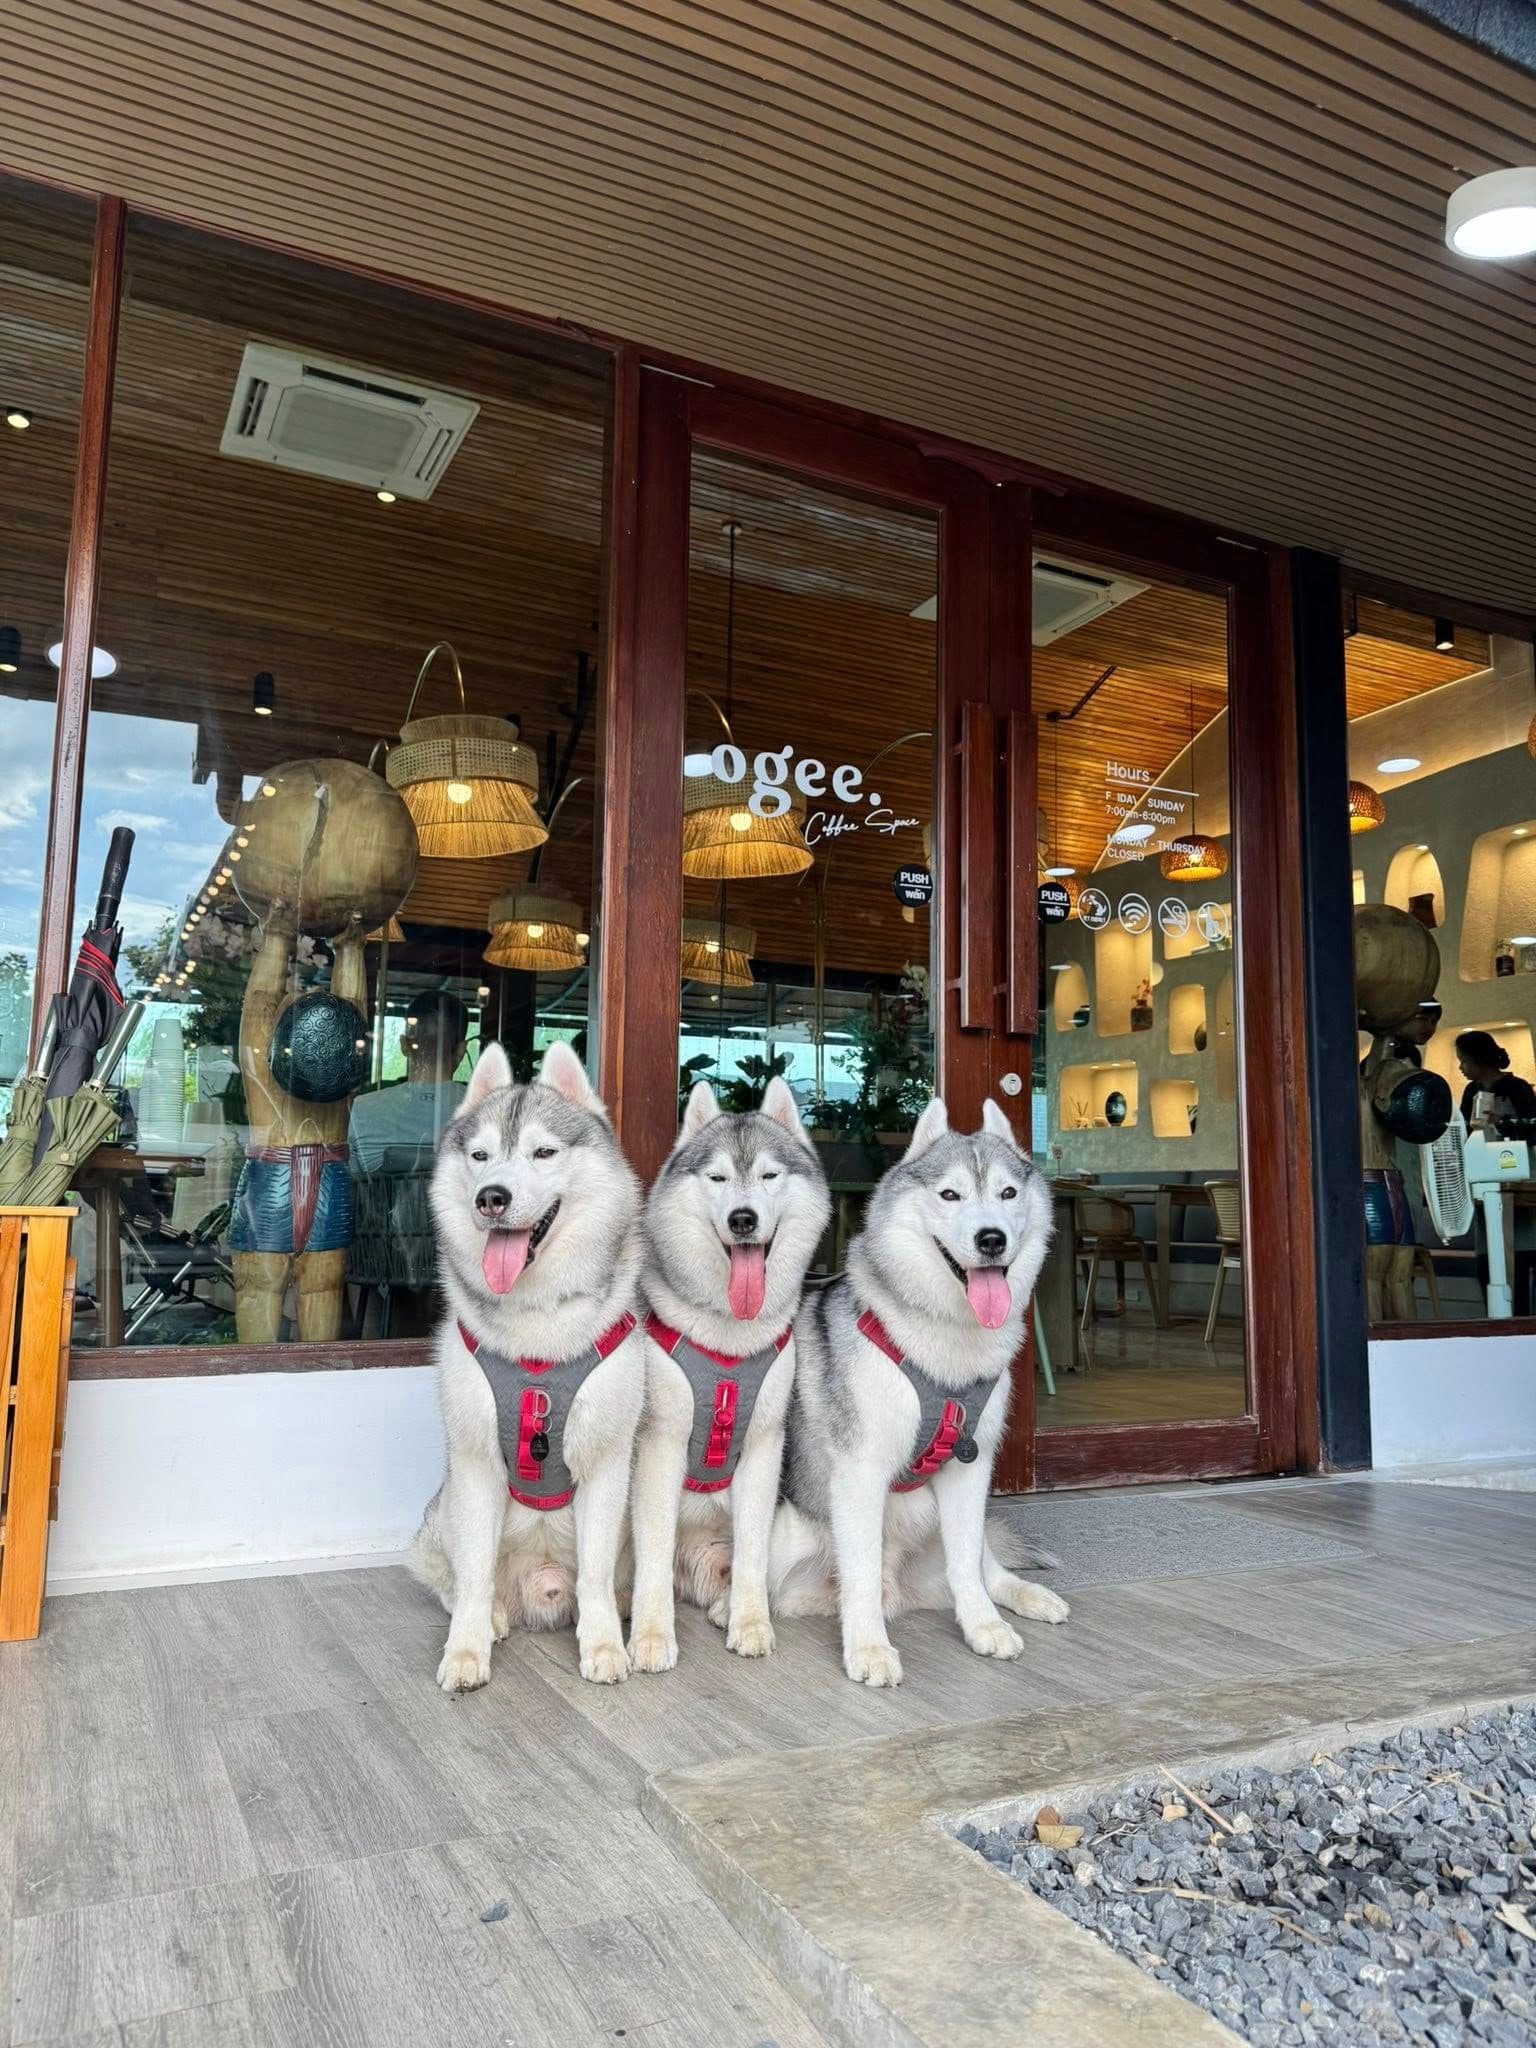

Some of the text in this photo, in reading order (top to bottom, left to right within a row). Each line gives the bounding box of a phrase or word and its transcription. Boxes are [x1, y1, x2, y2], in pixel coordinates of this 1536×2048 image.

[1106, 761, 1150, 782] Hours
[711, 744, 881, 818] ogee.
[1147, 798, 1185, 813] SUNDAY
[805, 808, 919, 845] Coffee Space
[1107, 848, 1144, 861] CLOSED
[1157, 841, 1207, 856] THURSDAY
[900, 872, 929, 885] PUSH
[1041, 890, 1067, 902] PUSH
